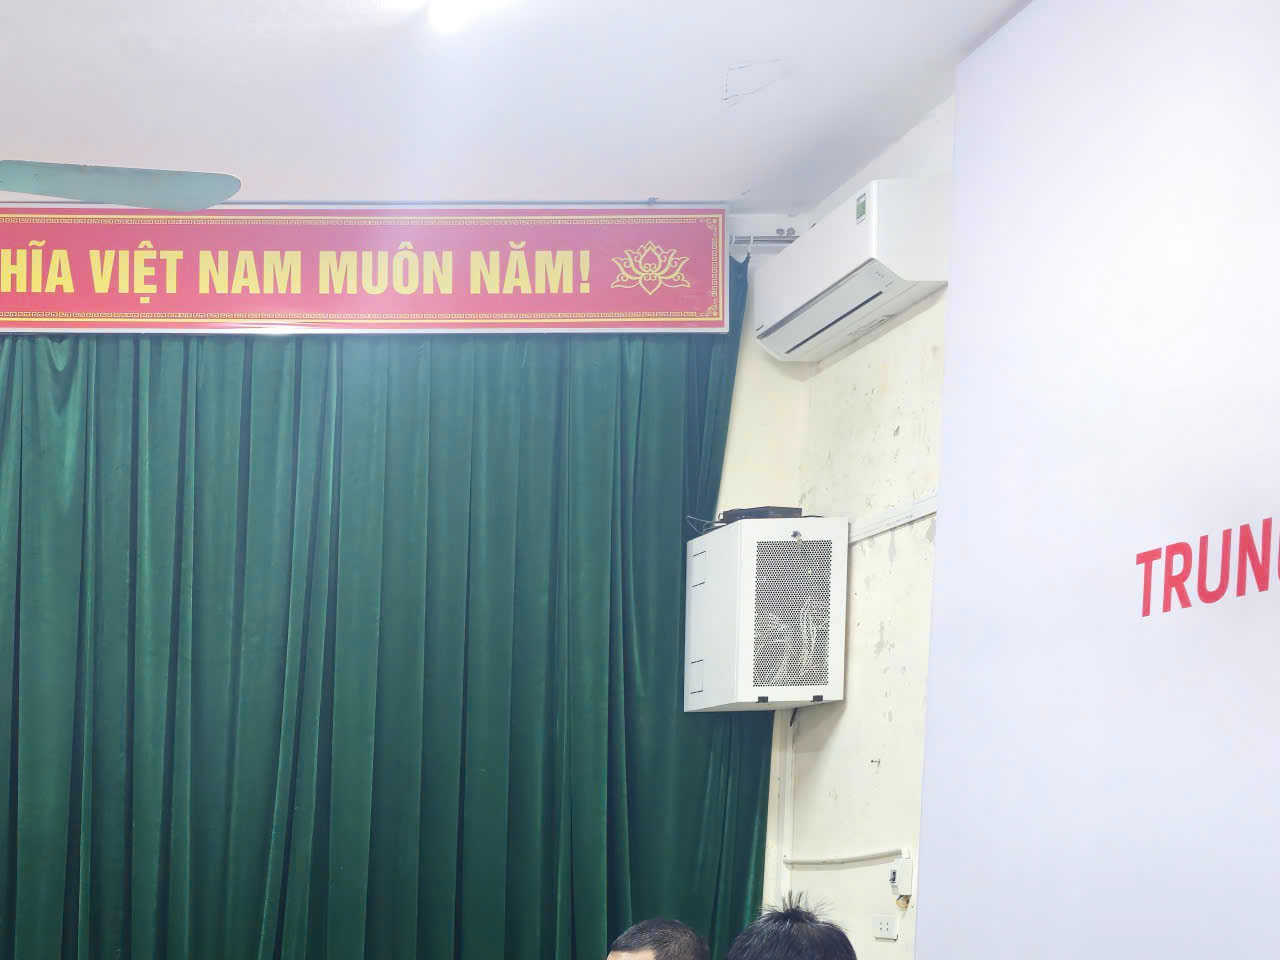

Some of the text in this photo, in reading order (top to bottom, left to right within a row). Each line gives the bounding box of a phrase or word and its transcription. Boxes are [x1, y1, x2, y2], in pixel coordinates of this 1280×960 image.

[88, 239, 185, 305] VIỆT
[198, 250, 302, 295] NAM
[319, 241, 453, 295] MUÔN
[470, 241, 590, 295] NĂM!
[1136, 516, 1280, 617] TRUN
